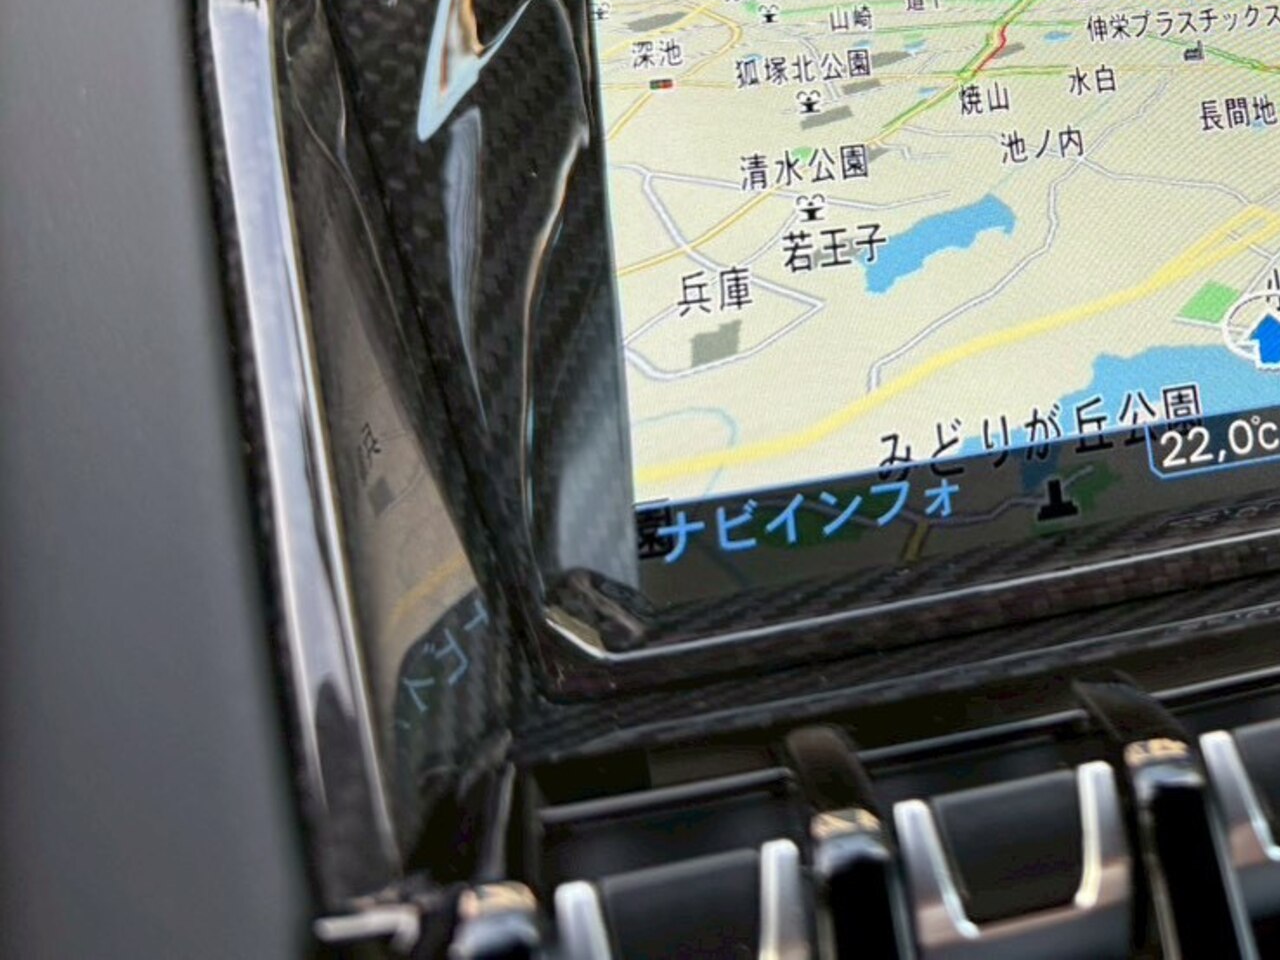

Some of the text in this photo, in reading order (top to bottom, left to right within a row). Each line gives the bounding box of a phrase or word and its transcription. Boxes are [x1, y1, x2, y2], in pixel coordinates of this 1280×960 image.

[829, 7, 873, 31] 山崎
[632, 40, 683, 69] 深池
[736, 48, 871, 88] 狐塚北公園
[959, 82, 1010, 116] 焼山
[1068, 64, 1116, 96] 水白
[1199, 93, 1278, 132] 長間地
[1000, 125, 1085, 165] 池ノ内
[740, 143, 870, 190] 清水公園
[782, 223, 888, 274] 若王子
[677, 266, 753, 318] 兵庫
[657, 478, 960, 564] ナビインフォ
